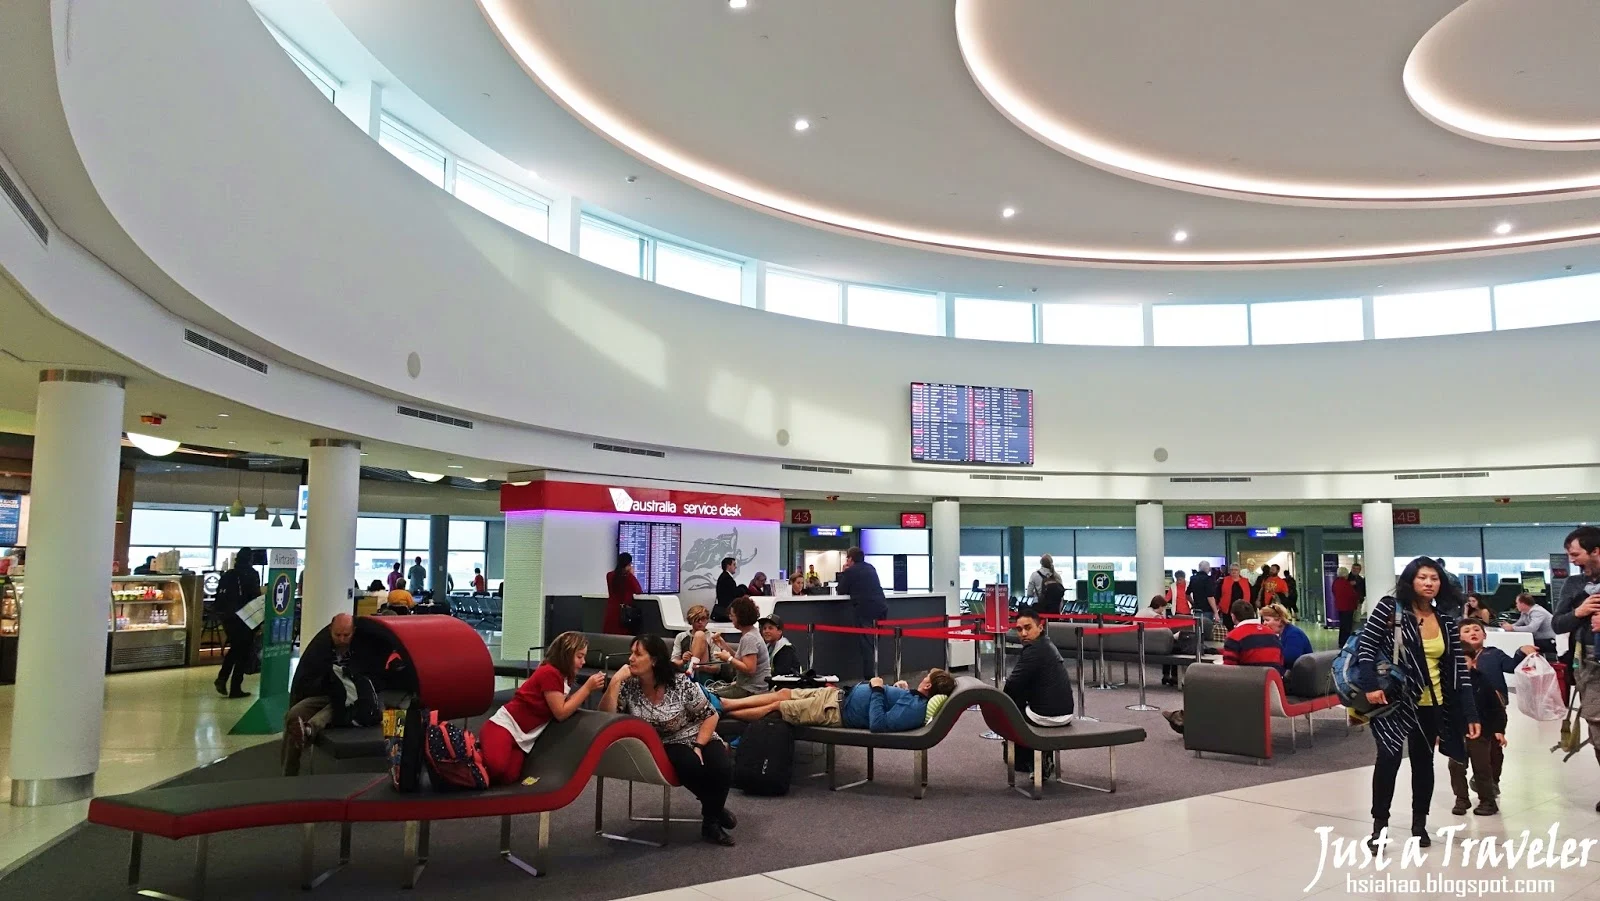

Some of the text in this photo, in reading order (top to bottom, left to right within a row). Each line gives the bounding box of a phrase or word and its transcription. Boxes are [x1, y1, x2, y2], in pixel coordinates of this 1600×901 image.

[632, 499, 677, 513] australia
[683, 502, 718, 515] service
[719, 503, 742, 517] desk
[794, 512, 809, 522] 43
[1217, 514, 1244, 524] 44A
[273, 553, 295, 565] Airtrain
